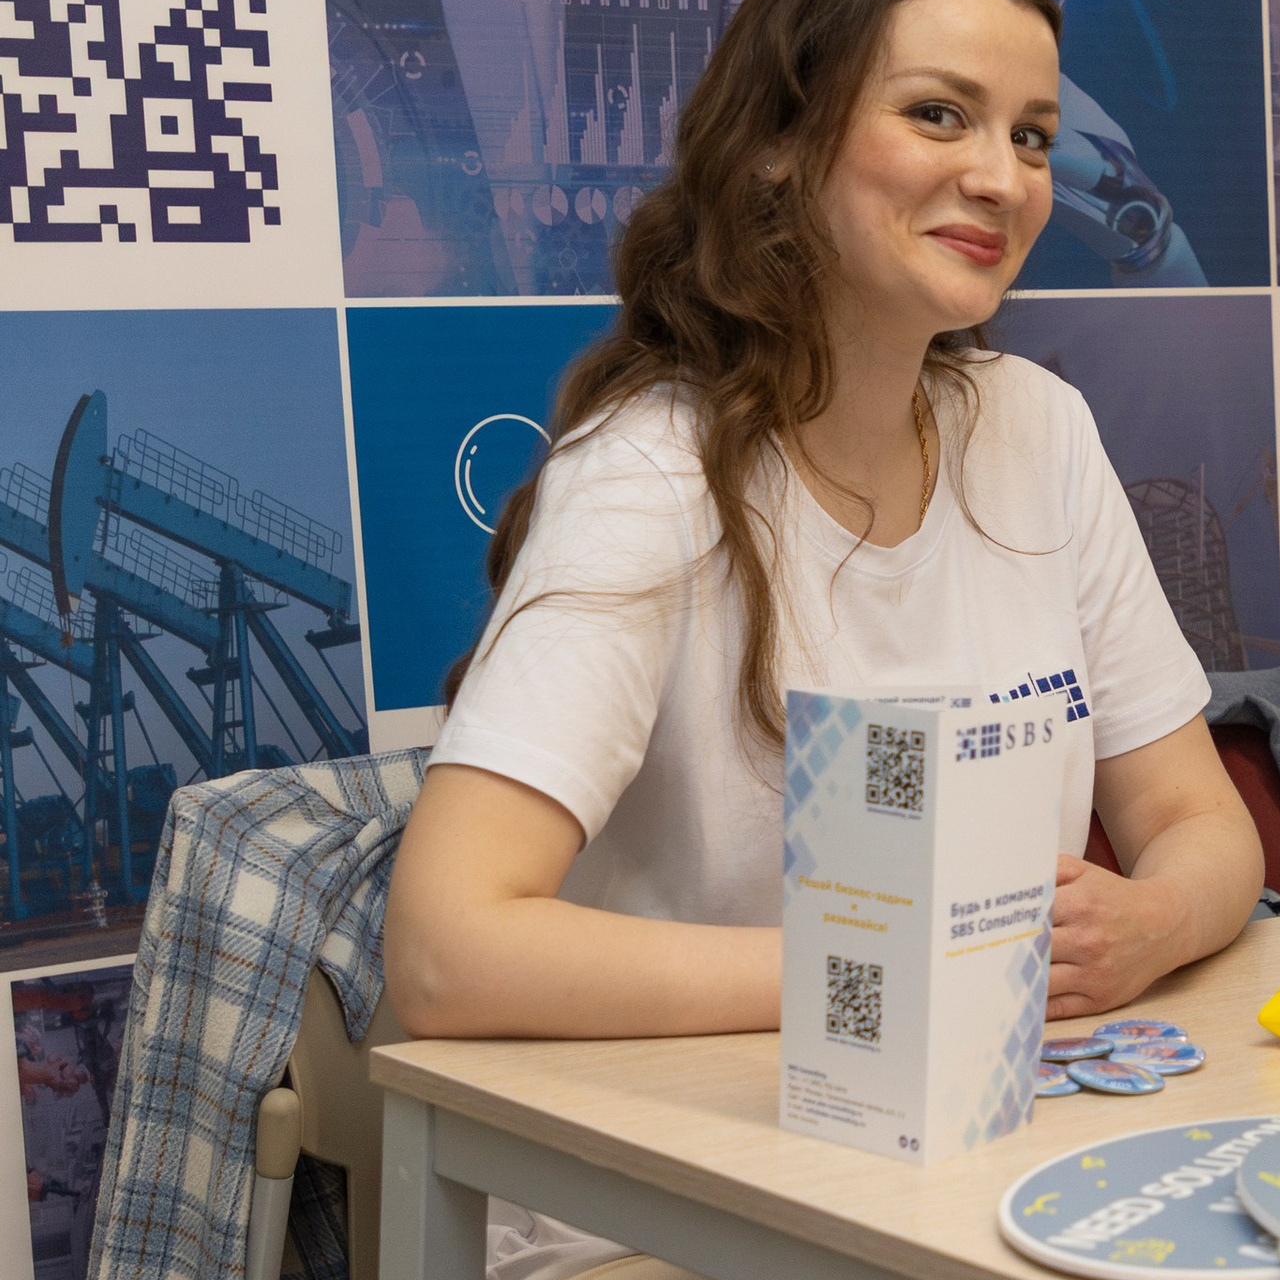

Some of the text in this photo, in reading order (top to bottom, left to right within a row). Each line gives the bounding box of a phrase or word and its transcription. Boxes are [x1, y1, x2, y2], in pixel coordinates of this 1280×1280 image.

[1005, 717, 1054, 750] SBS
[950, 884, 1044, 918] Будь в команде
[1046, 1197, 1165, 1250] NEED
